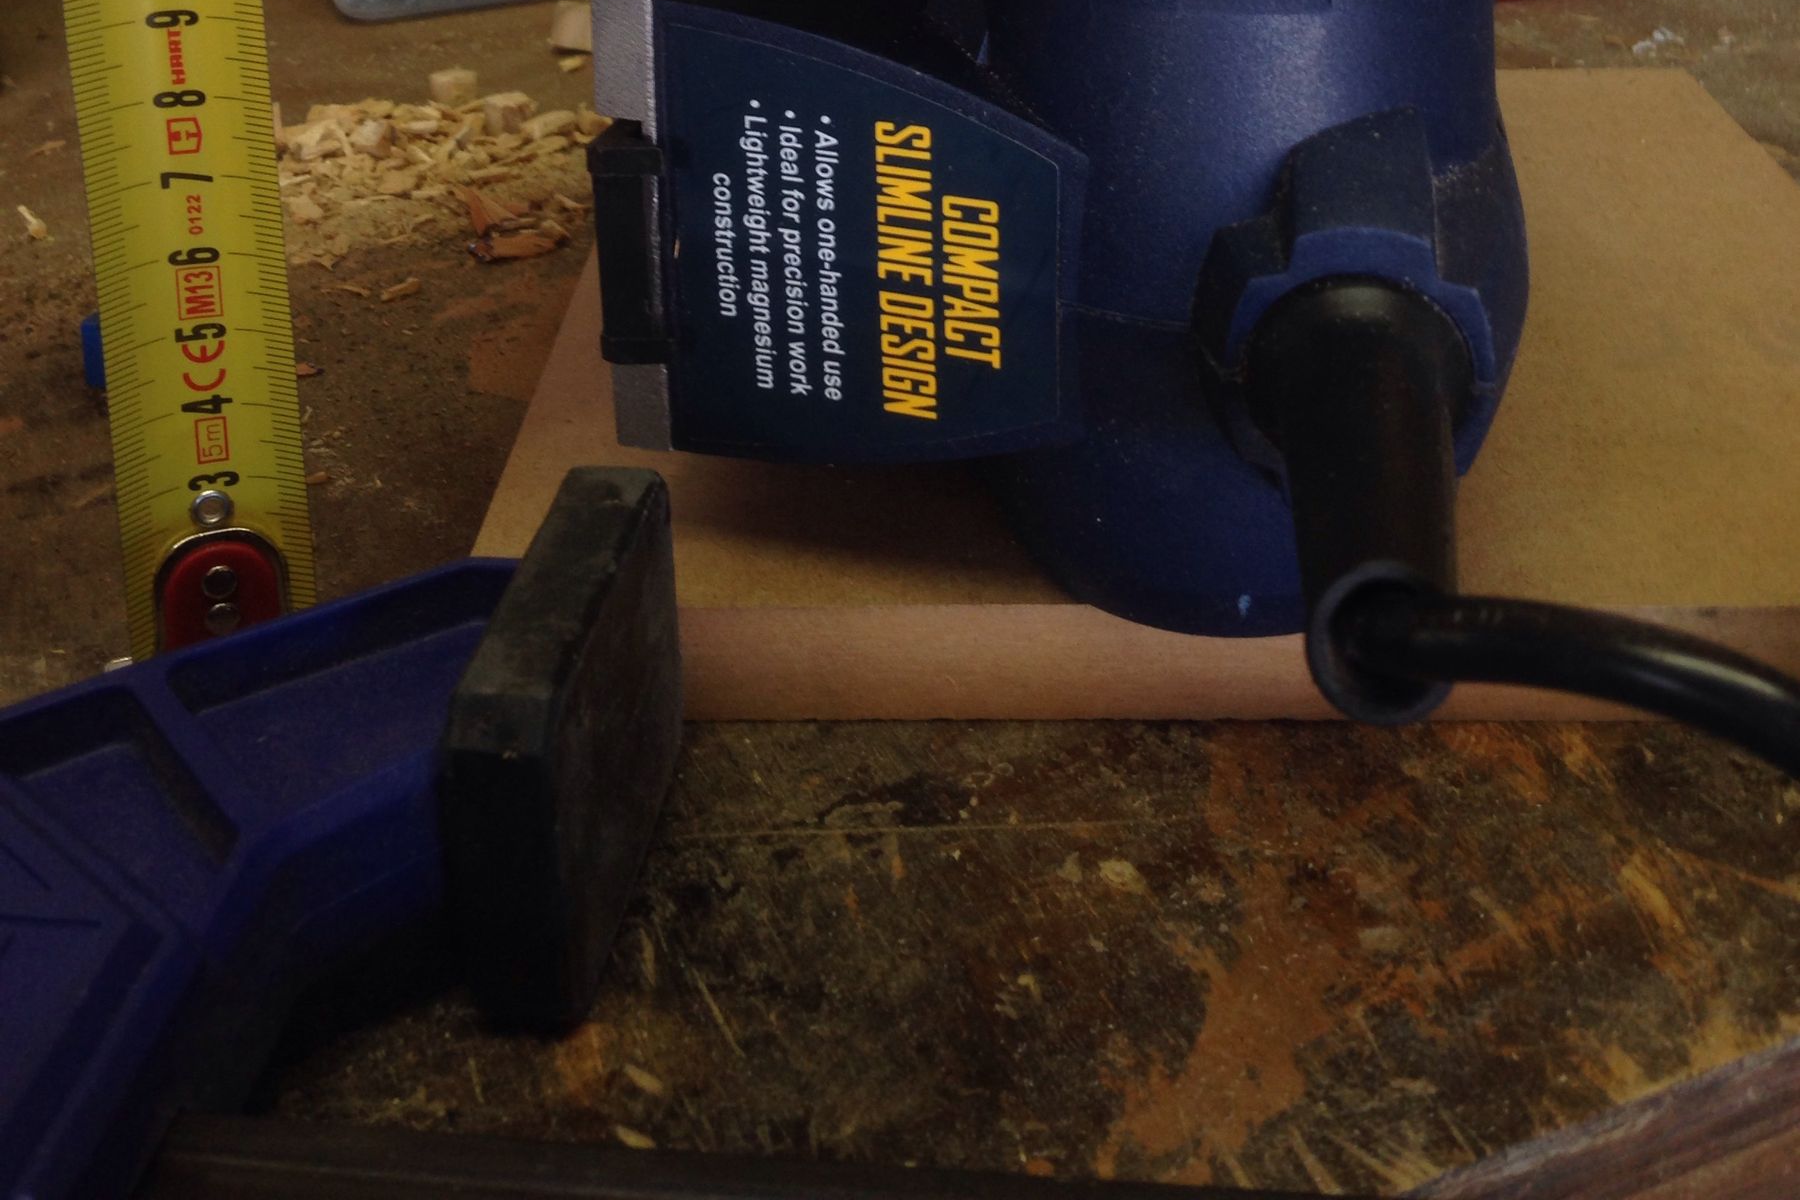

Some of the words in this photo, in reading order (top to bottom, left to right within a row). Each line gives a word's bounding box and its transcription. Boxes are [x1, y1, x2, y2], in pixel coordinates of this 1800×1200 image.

[145, 9, 199, 29] 9
[152, 89, 206, 109] 8
[160, 171, 214, 189] 7
[779, 124, 803, 182] Ideal
[814, 130, 839, 212] Allows
[741, 115, 774, 255] Lightweight
[780, 185, 807, 223] for
[875, 121, 933, 286] SLIMLINE
[186, 194, 203, 235] 0122
[168, 247, 220, 266] 6
[713, 173, 738, 317] construction
[777, 227, 805, 335] precision
[817, 218, 845, 354] one-handed
[942, 195, 1001, 369] COMPACT
[174, 322, 227, 344] 5
[746, 260, 774, 389] magnesium
[788, 339, 811, 395] work
[823, 360, 842, 400] use
[879, 290, 938, 420] DESIGN
[181, 394, 234, 415] 4
[188, 470, 240, 492] 3
